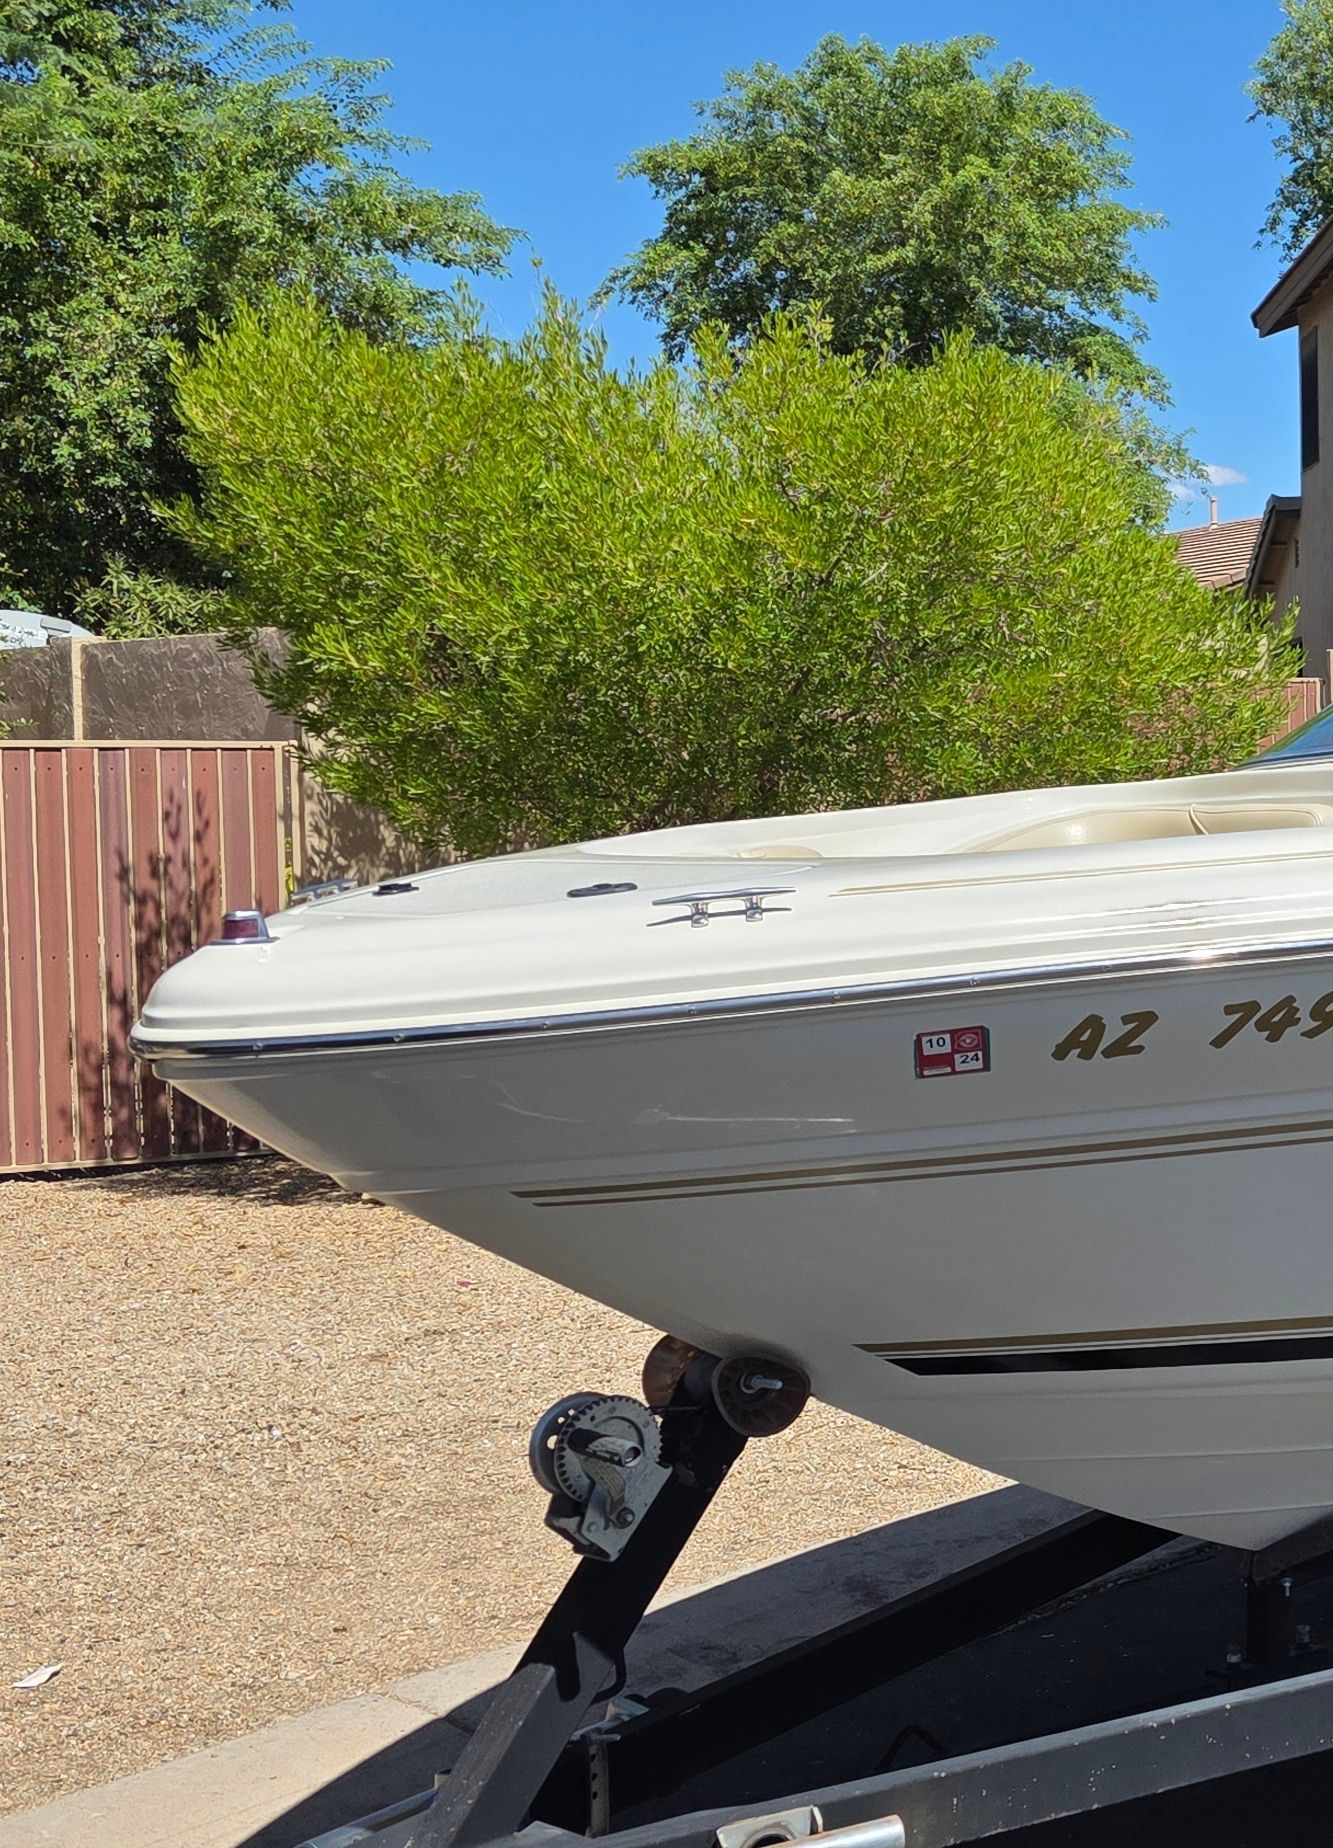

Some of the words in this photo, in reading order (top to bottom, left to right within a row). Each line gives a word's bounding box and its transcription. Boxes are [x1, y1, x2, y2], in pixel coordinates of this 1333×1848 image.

[1050, 1010, 1160, 1061] AZ
[925, 1037, 946, 1049] 10
[959, 1052, 980, 1065] 24
